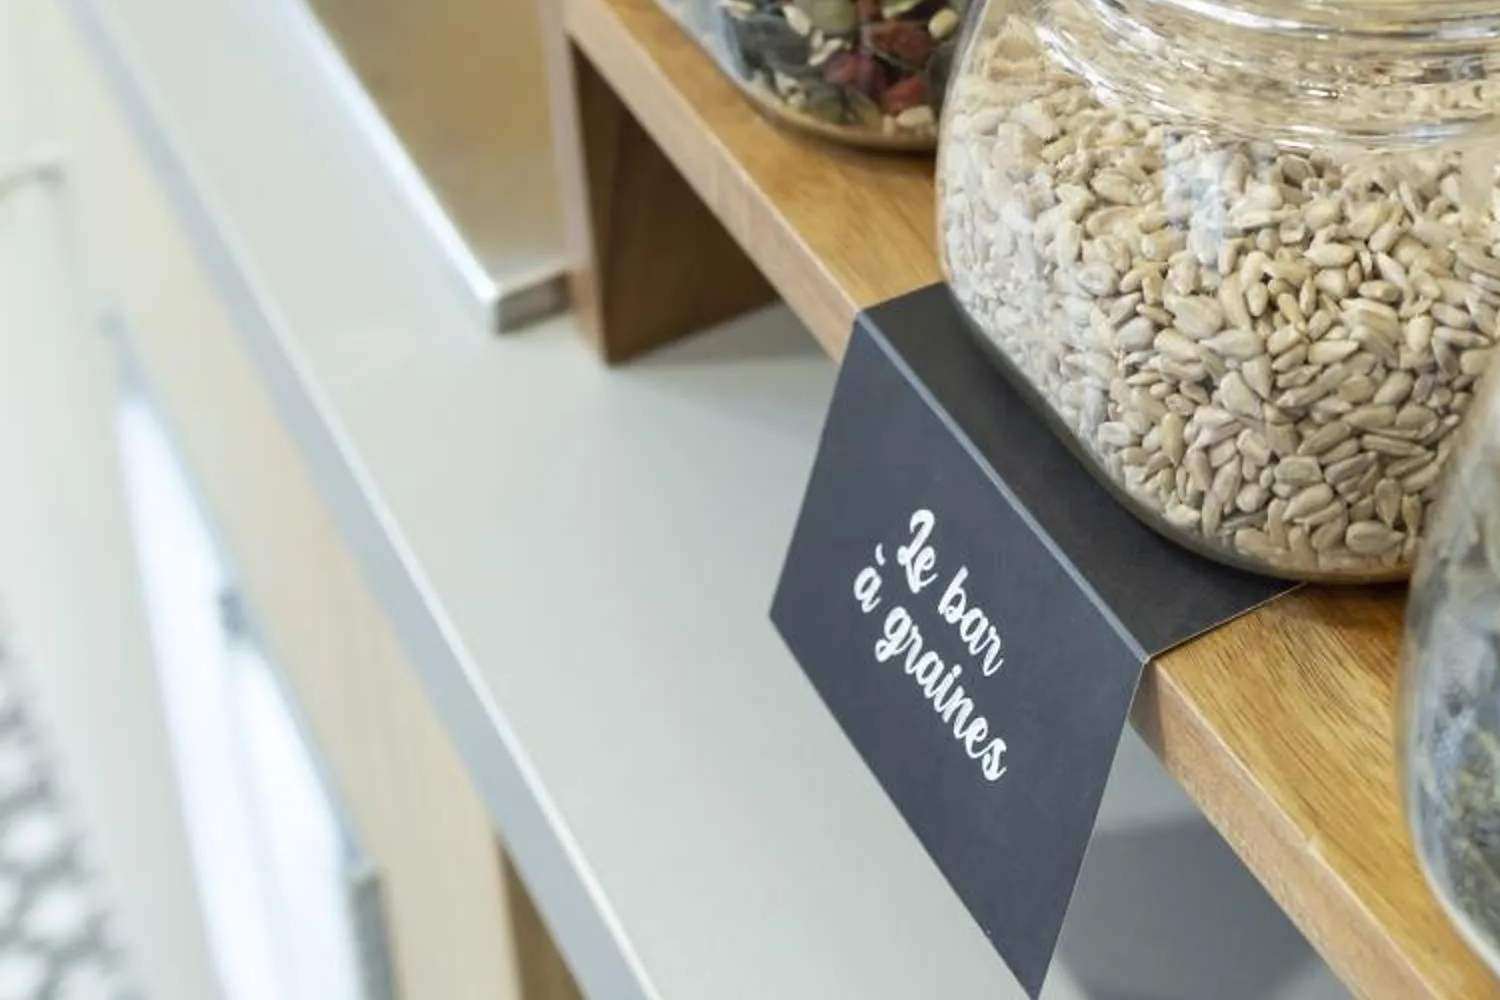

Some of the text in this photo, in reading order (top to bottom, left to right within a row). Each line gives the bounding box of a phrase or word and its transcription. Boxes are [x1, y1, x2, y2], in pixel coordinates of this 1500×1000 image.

[854, 543, 1007, 781] à graines
[897, 509, 1004, 676] Le bar
